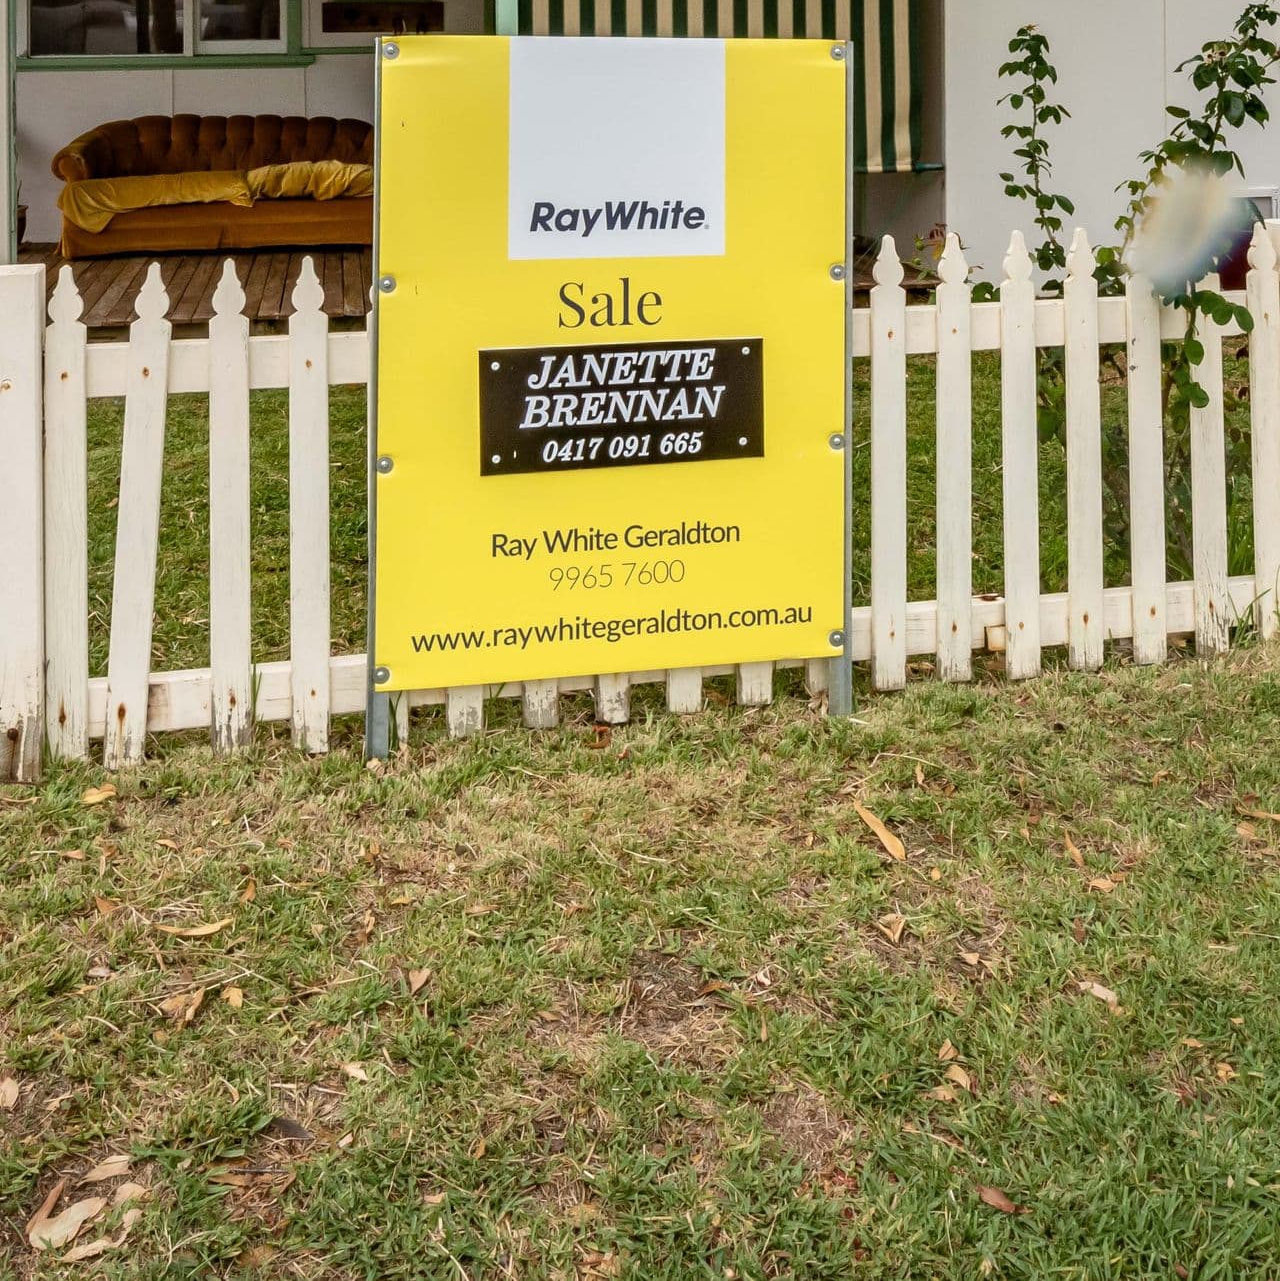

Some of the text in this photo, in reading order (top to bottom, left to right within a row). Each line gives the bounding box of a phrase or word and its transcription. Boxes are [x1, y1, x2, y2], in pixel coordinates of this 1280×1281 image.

[558, 277, 663, 329] Sale
[527, 348, 716, 390] JANETTE
[519, 385, 726, 429] BRENNAN
[542, 431, 704, 463] 0417 091 665
[491, 521, 740, 560] Ray White Geraldton
[549, 559, 685, 591] 9965 7600
[411, 605, 813, 652] www.raywhitegeraldton.com.au
